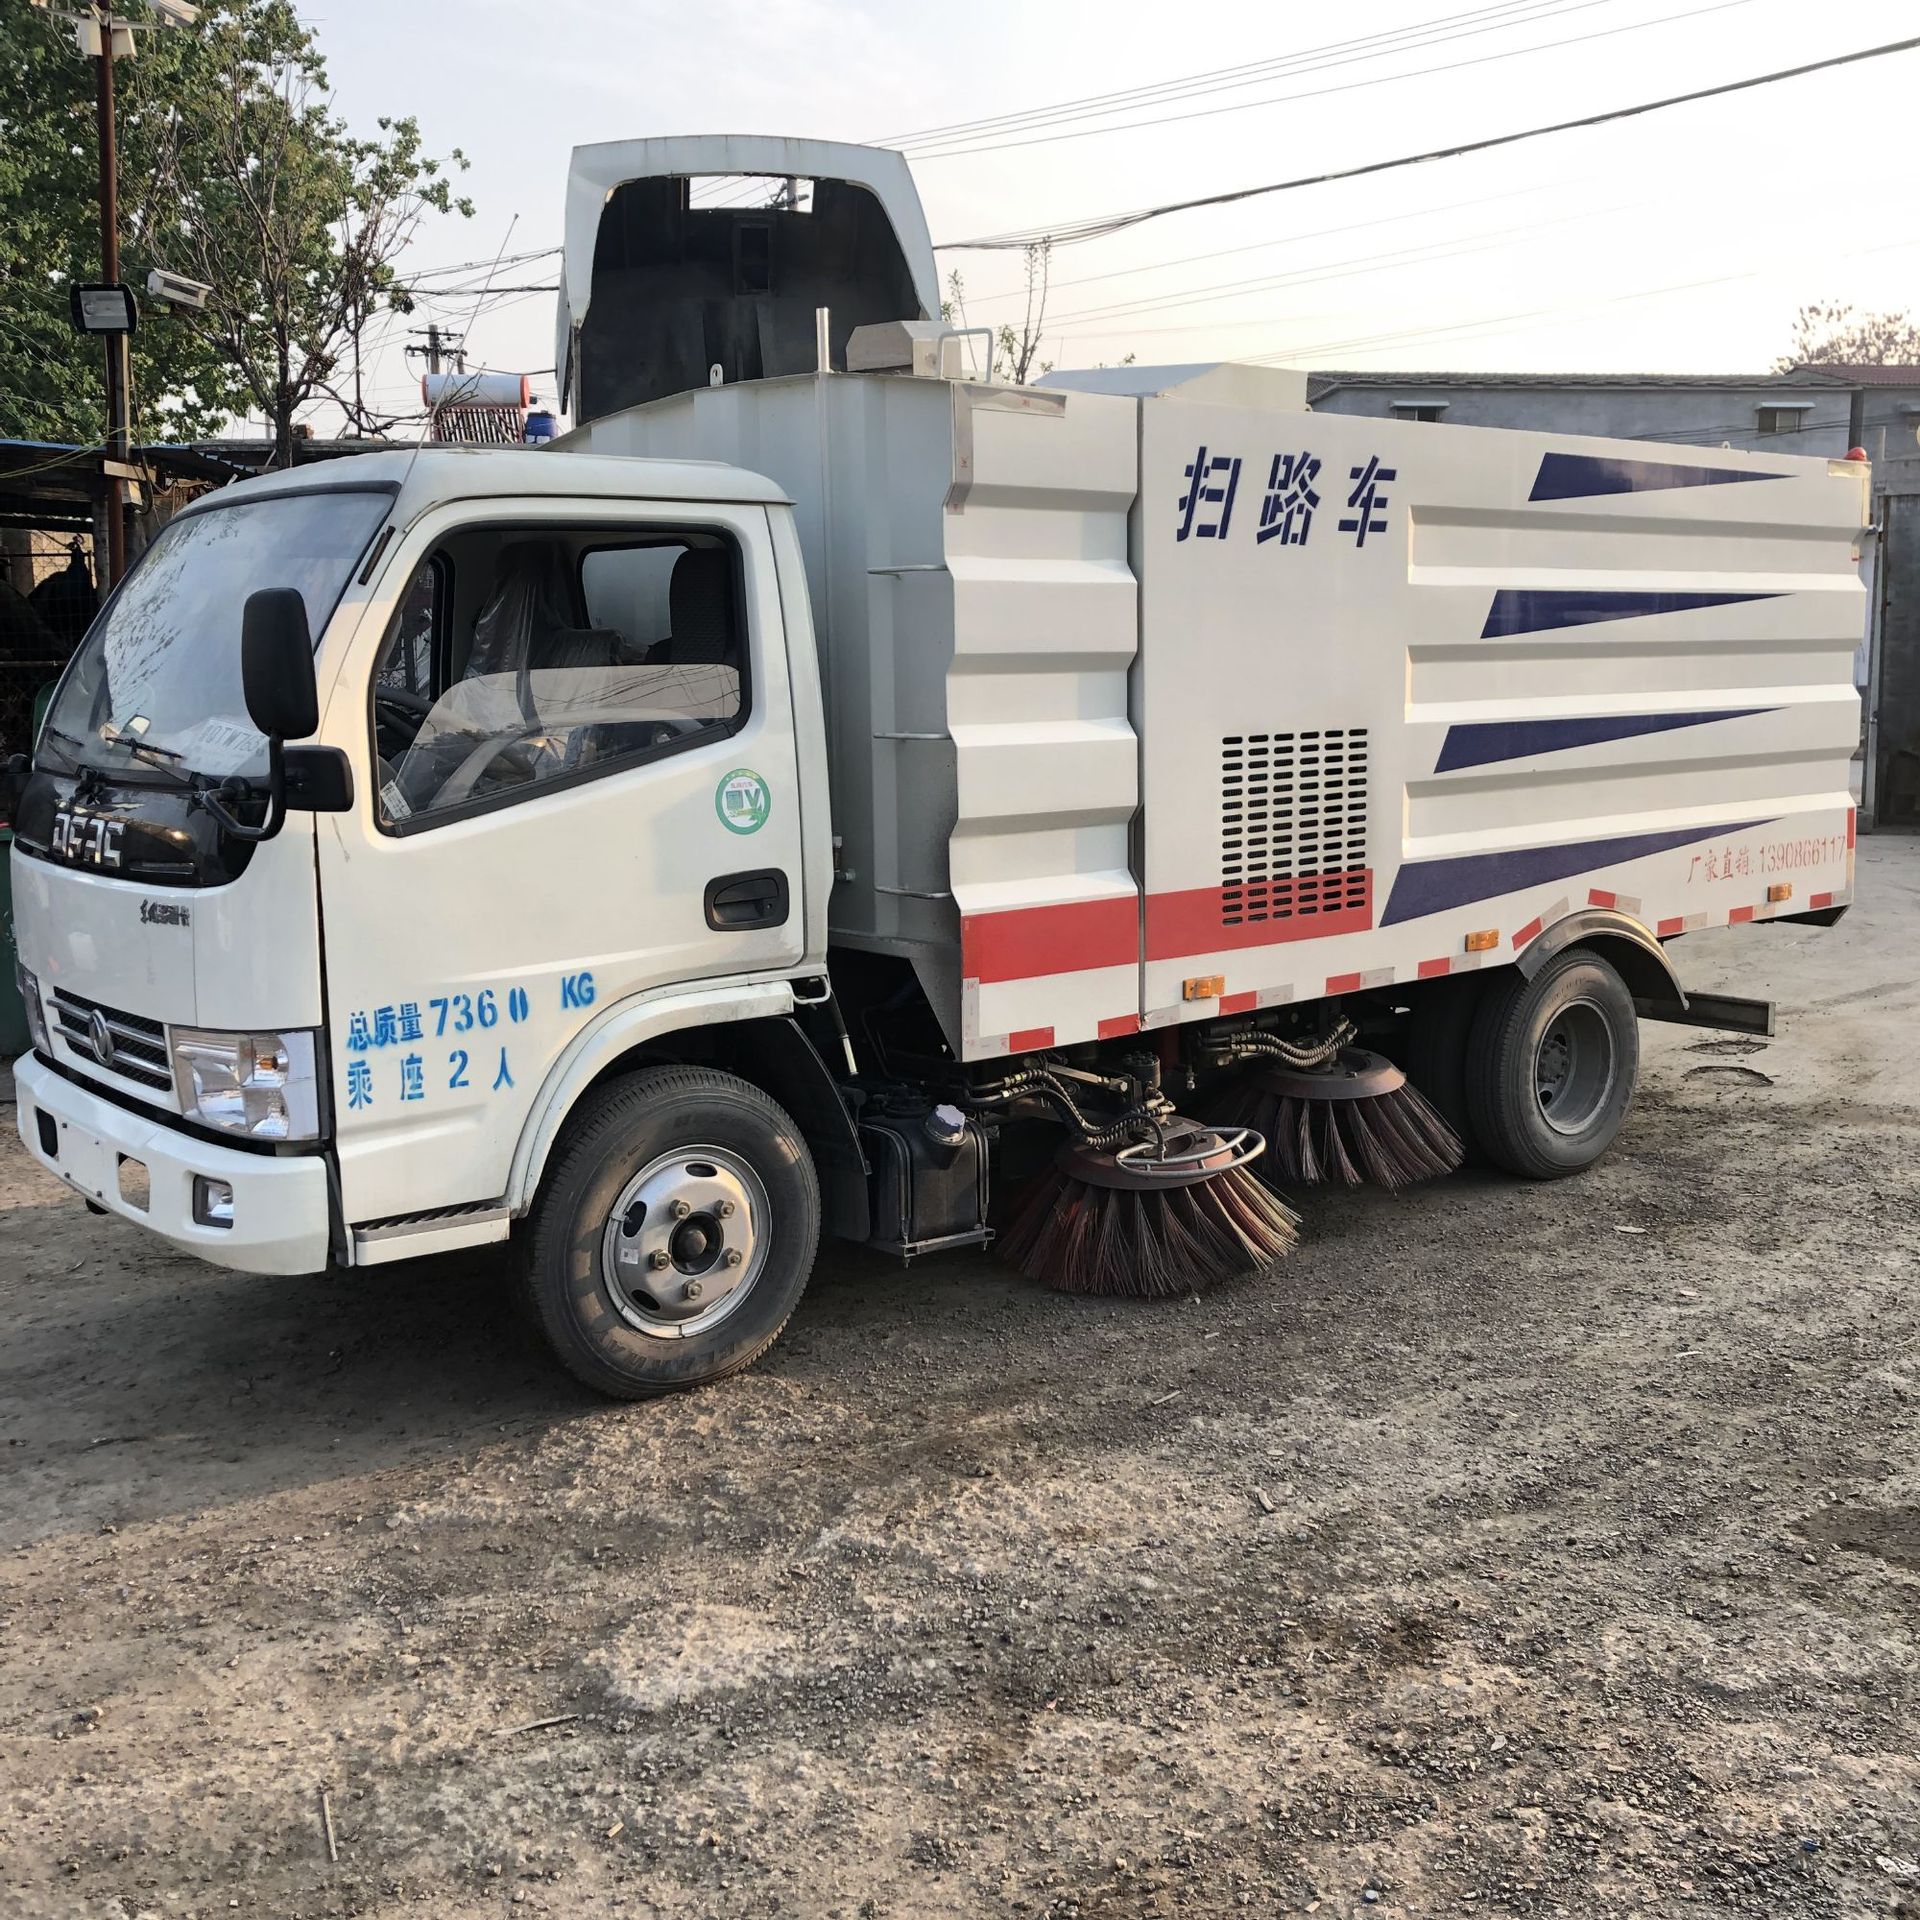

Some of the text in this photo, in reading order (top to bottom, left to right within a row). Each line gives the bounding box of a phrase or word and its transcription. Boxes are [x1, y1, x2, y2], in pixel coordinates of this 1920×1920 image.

[1177, 446, 1397, 548] 扫路车
[561, 972, 595, 1009] KG
